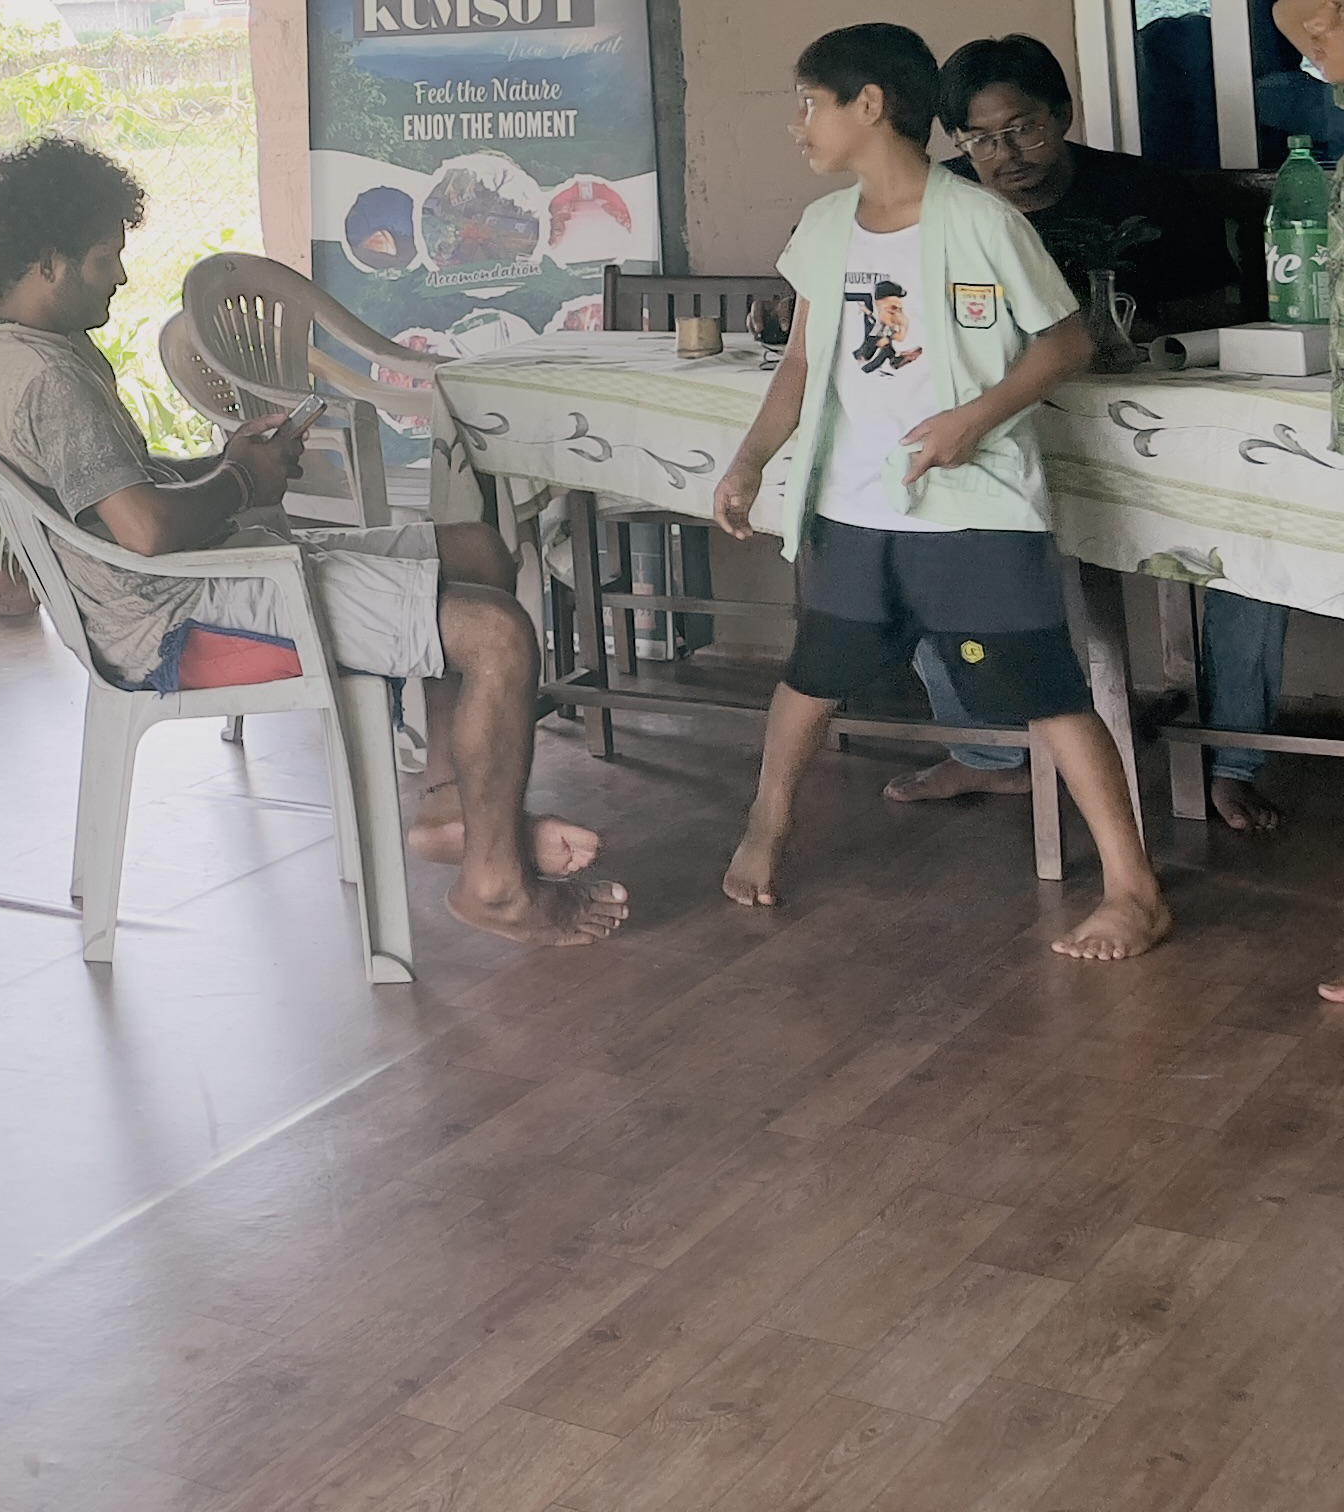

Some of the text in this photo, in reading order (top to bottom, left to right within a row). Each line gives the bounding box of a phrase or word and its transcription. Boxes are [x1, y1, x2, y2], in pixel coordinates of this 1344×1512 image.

[413, 77, 562, 104] Feel the Nature
[403, 109, 578, 142] ENJOY THE MOMENT
